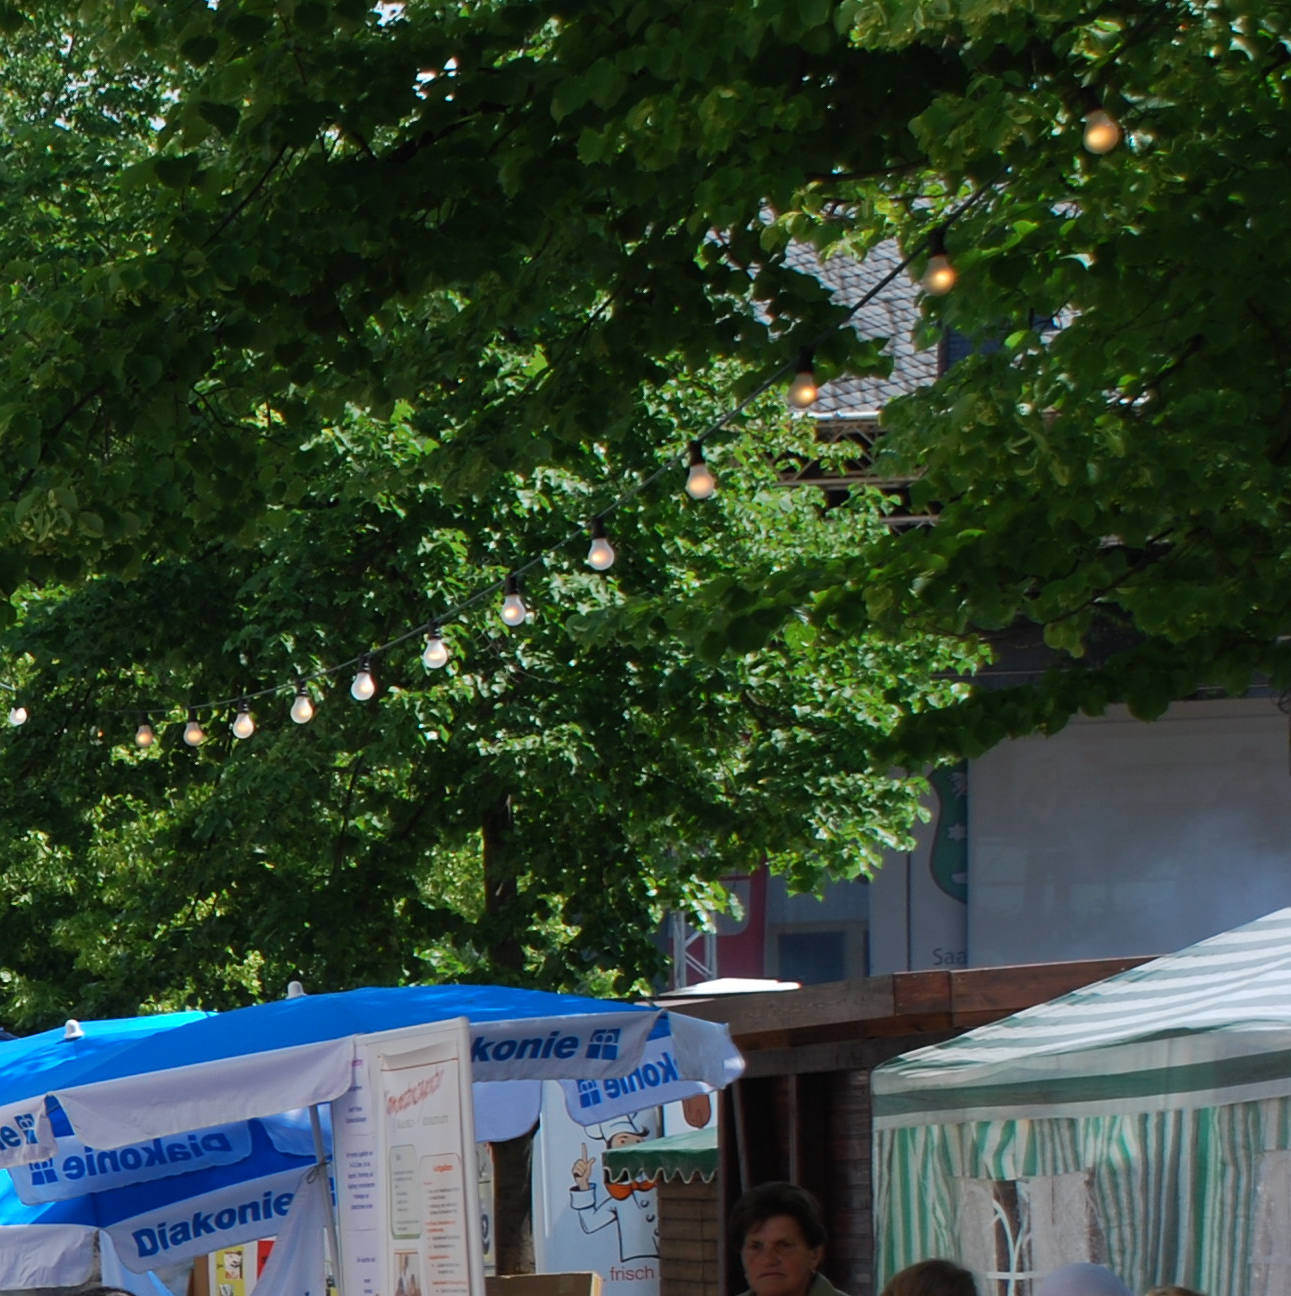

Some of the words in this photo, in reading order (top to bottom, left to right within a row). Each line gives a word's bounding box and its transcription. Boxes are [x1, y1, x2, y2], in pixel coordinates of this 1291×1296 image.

[471, 1031, 579, 1063] konie
[132, 1190, 295, 1258] Diakonie
[610, 1265, 655, 1281] frisch
